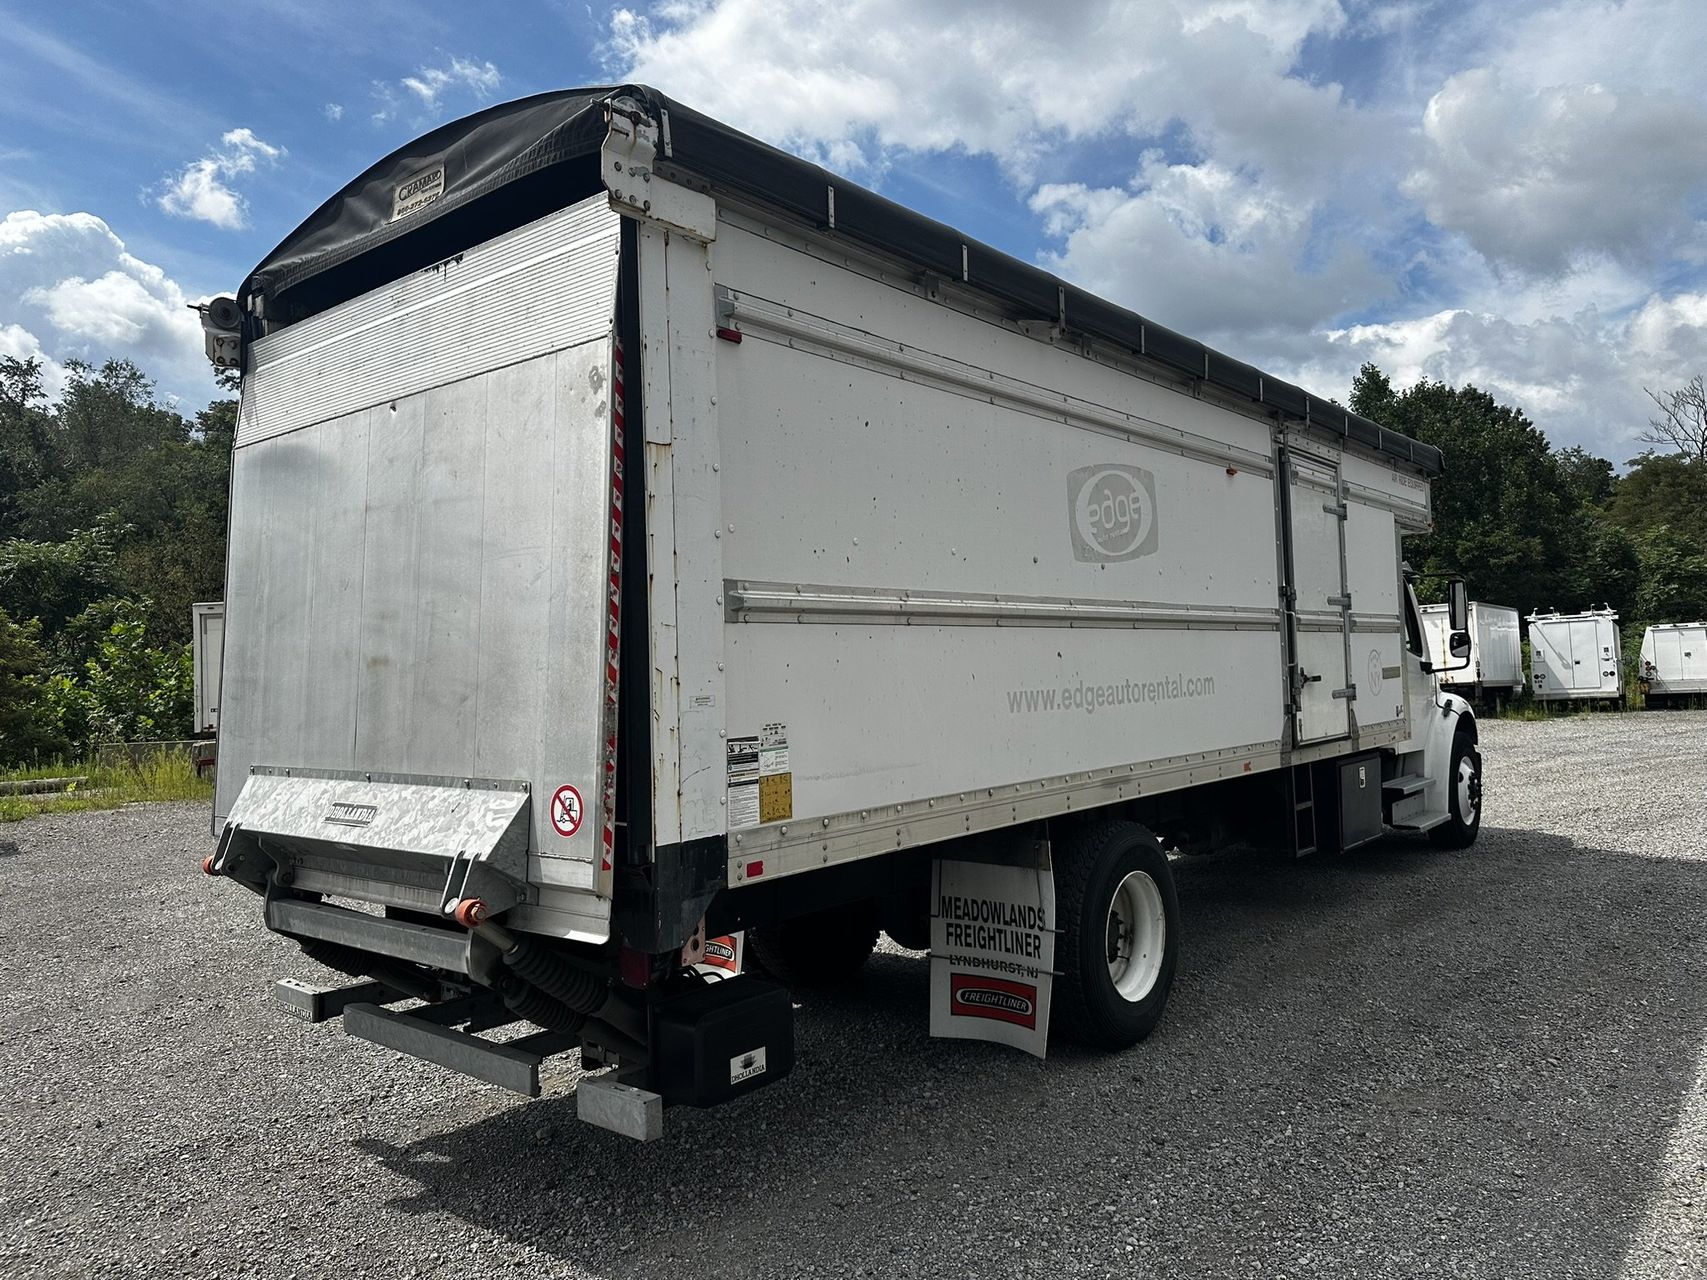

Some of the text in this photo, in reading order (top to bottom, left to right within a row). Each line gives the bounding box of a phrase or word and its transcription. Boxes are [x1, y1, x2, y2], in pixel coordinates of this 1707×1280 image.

[1087, 489, 1141, 535] edge
[1006, 673, 1215, 714] www.edgeautorental.com
[324, 805, 377, 821] DHOLLANDIA
[941, 896, 1046, 932] MEADOWLANDS
[945, 922, 1041, 960] FREIGHTLINER
[1027, 965, 1038, 979] NJ
[964, 992, 1027, 1011] FREIGHTLINER
[731, 1064, 765, 1082] DHOLLANDIA
